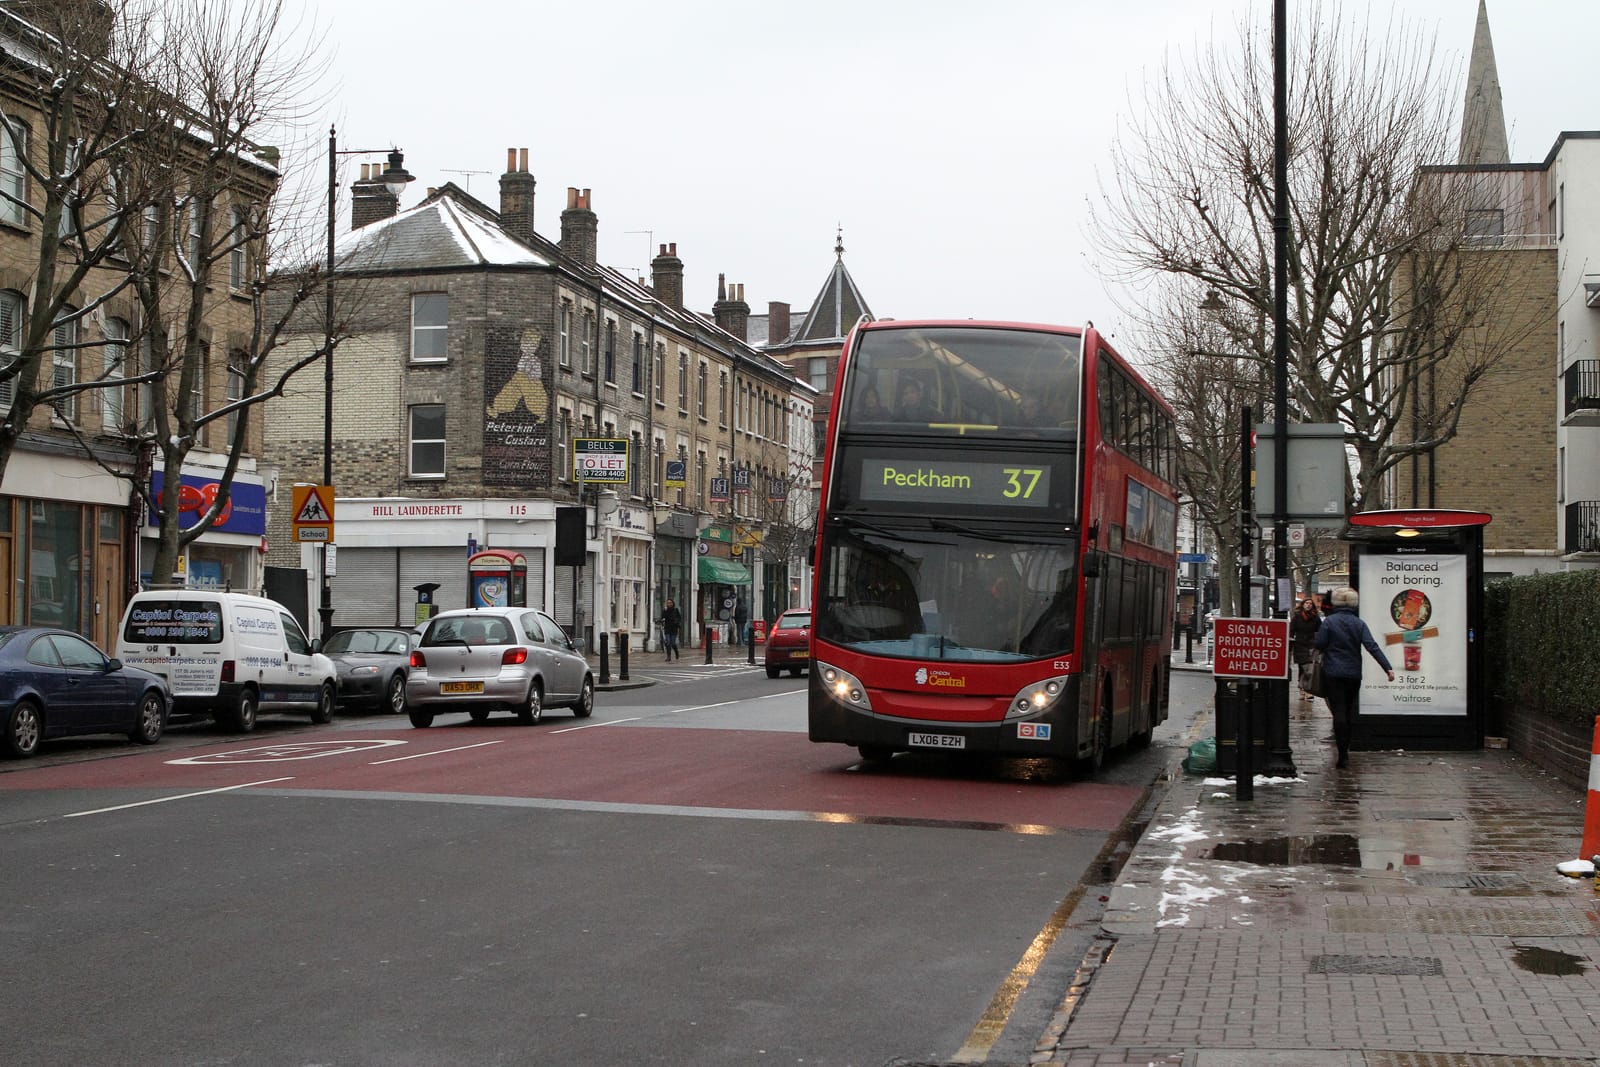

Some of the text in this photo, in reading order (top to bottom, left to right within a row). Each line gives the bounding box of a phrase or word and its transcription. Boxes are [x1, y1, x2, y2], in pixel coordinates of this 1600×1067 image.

[587, 441, 615, 450] BELLS
[600, 459, 625, 469] LET
[883, 467, 1043, 499] Peckham 37
[372, 505, 527, 516] HILL LAUNDERETTE 115
[301, 530, 326, 538] School
[1386, 561, 1439, 571] Balanced
[1381, 574, 1443, 588] not boring.
[132, 609, 218, 622] Capitol Carpets
[236, 617, 277, 631] Capitol Carpets
[1227, 624, 1271, 636] SIGNAL
[1218, 636, 1282, 648] PRIORITIES
[1220, 648, 1279, 660] CHANGED
[125, 656, 218, 666] www.capitolcarpets.co.uk
[1053, 661, 1070, 670] E33
[1228, 660, 1268, 672] AHEAD
[929, 675, 966, 688] Central
[1398, 675, 1426, 684] 3 for 2
[1392, 695, 1432, 703] Waitrose
[912, 734, 962, 747] LX06 EZH
